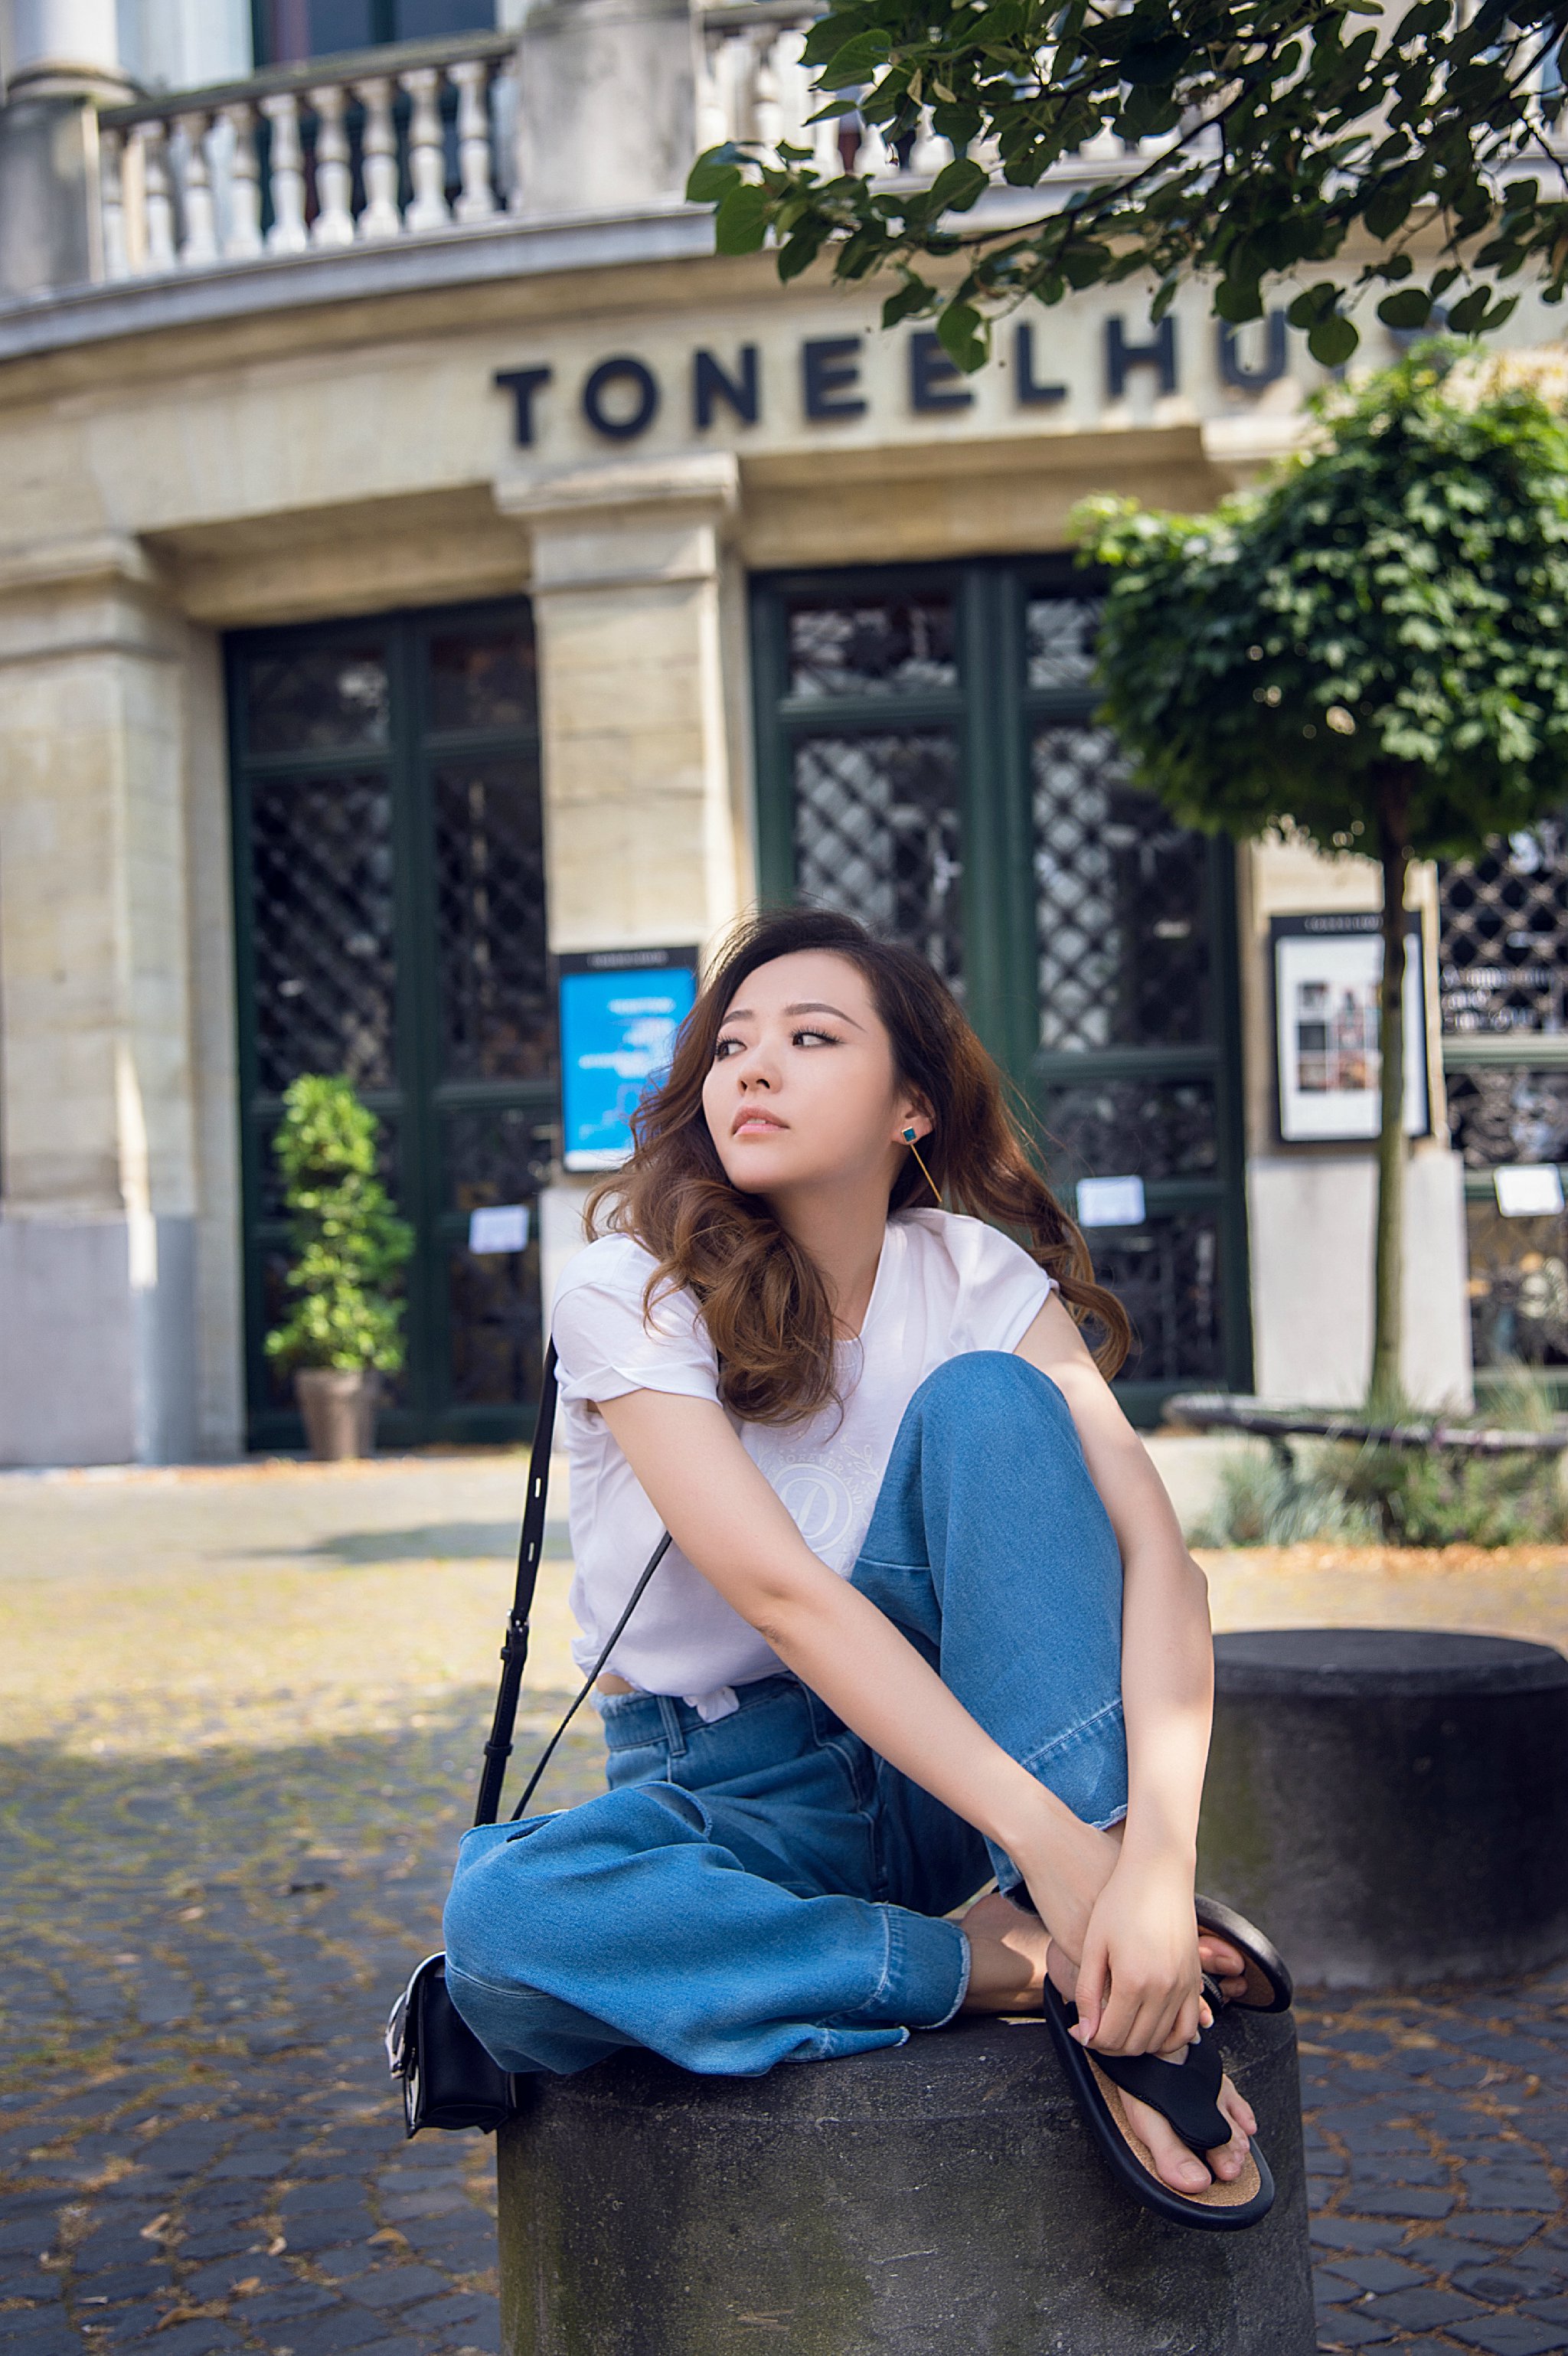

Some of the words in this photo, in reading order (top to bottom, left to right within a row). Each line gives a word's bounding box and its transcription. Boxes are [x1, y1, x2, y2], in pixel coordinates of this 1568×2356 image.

[492, 299, 1452, 449] TONEELHU
[777, 1453, 844, 1475] FOREVER
[844, 1475, 864, 1505] AND
